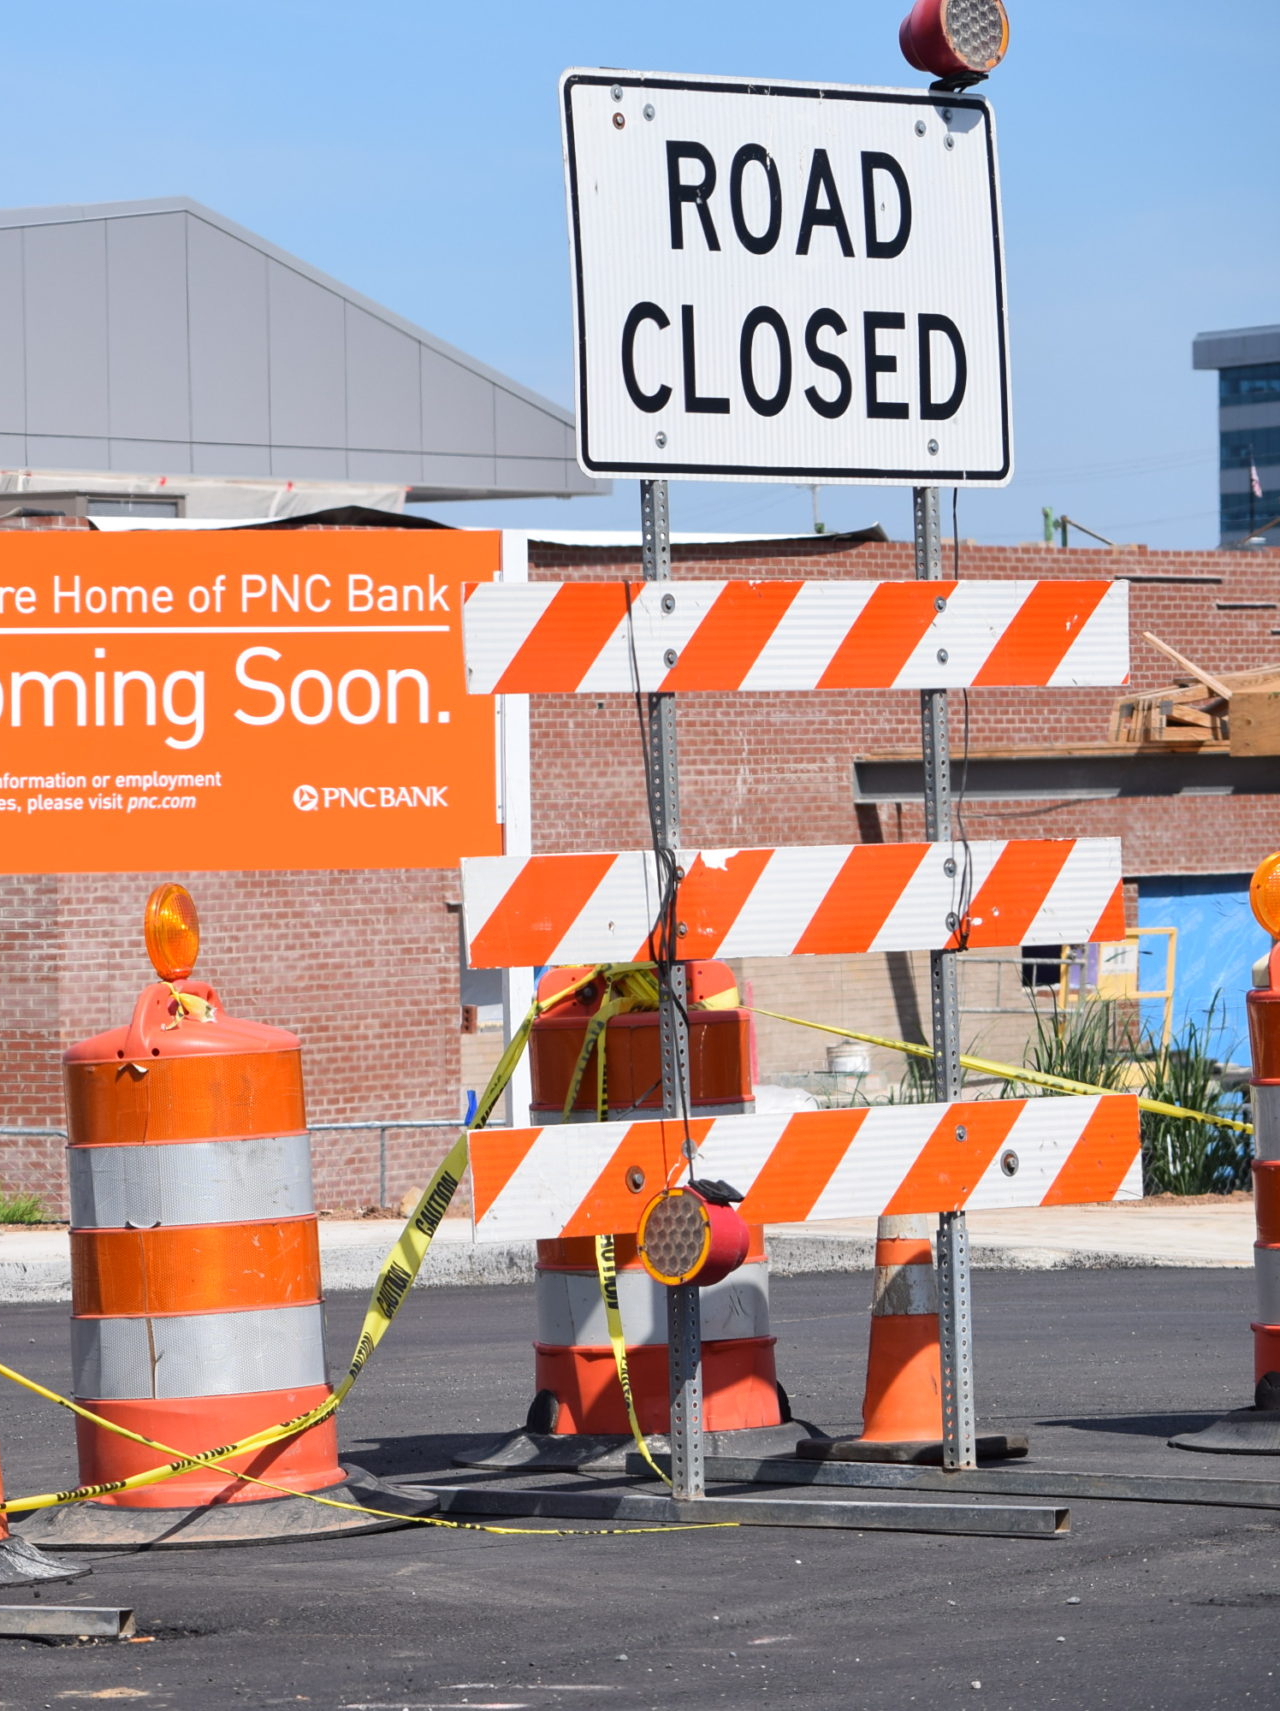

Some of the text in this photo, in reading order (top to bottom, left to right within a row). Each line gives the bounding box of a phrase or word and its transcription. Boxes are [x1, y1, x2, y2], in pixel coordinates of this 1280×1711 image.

[666, 140, 912, 259] ROAD
[622, 301, 967, 421] CLOSED
[53, 575, 174, 614] Home
[189, 574, 227, 613] of
[241, 574, 332, 613] PNC
[348, 573, 451, 612] Bank
[234, 645, 451, 727] Soon.
[27, 794, 84, 815] please
[88, 793, 124, 810] visit
[127, 795, 197, 814] pnc.com
[92, 775, 111, 789] or
[115, 771, 223, 792] employment
[321, 786, 449, 808] PNC BANK
[415, 1170, 458, 1239] CAUTION
[375, 1261, 412, 1320] CAUTION
